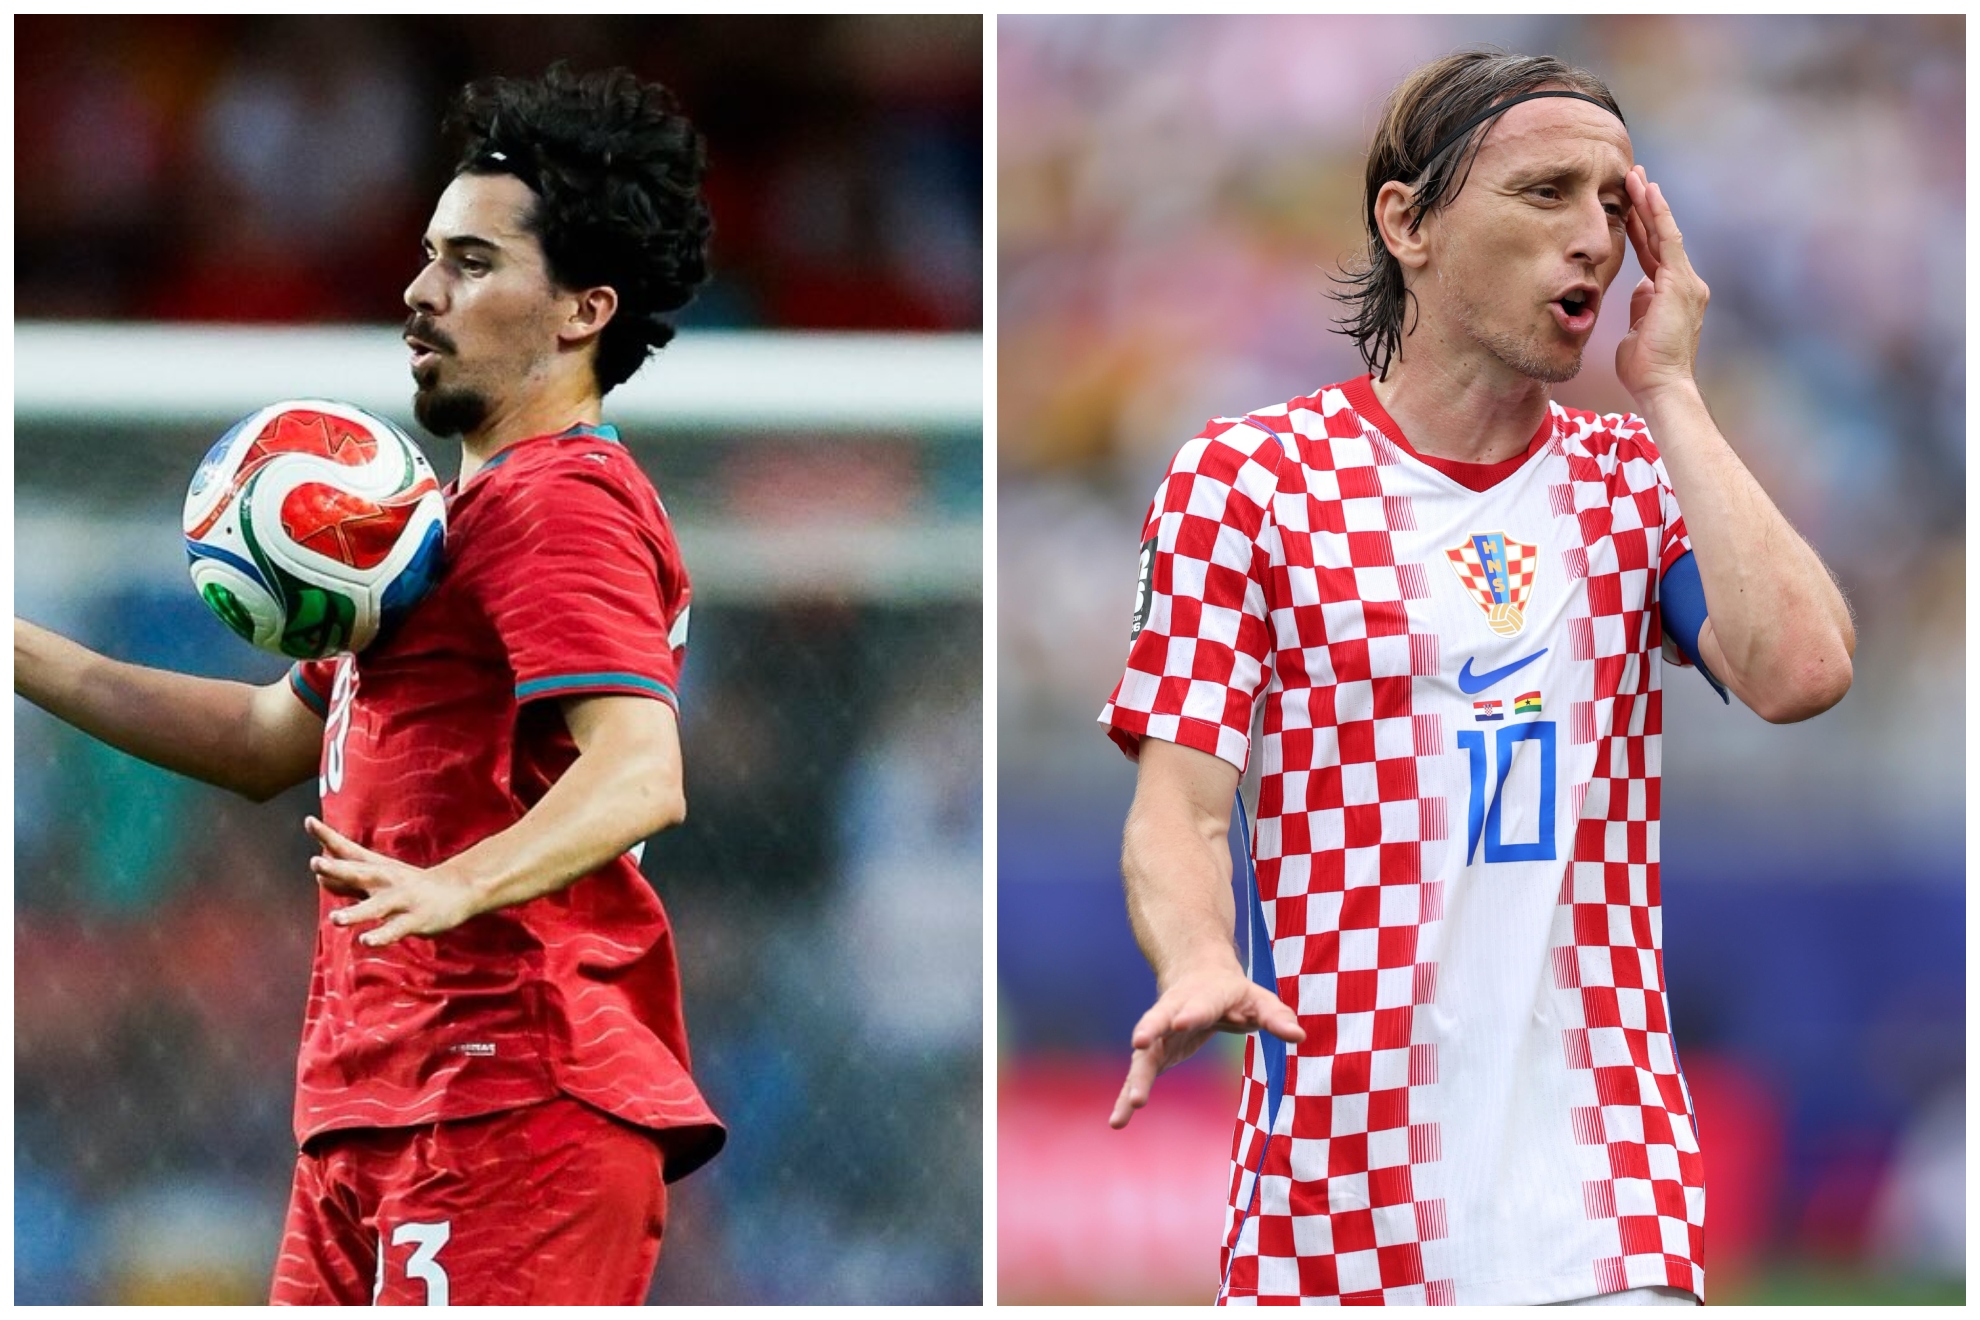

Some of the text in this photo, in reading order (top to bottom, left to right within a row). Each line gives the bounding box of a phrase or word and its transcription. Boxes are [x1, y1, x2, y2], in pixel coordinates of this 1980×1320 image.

[1482, 540, 1506, 593] HNS
[1456, 721, 1557, 868] 10
[372, 1220, 450, 1307] 3
